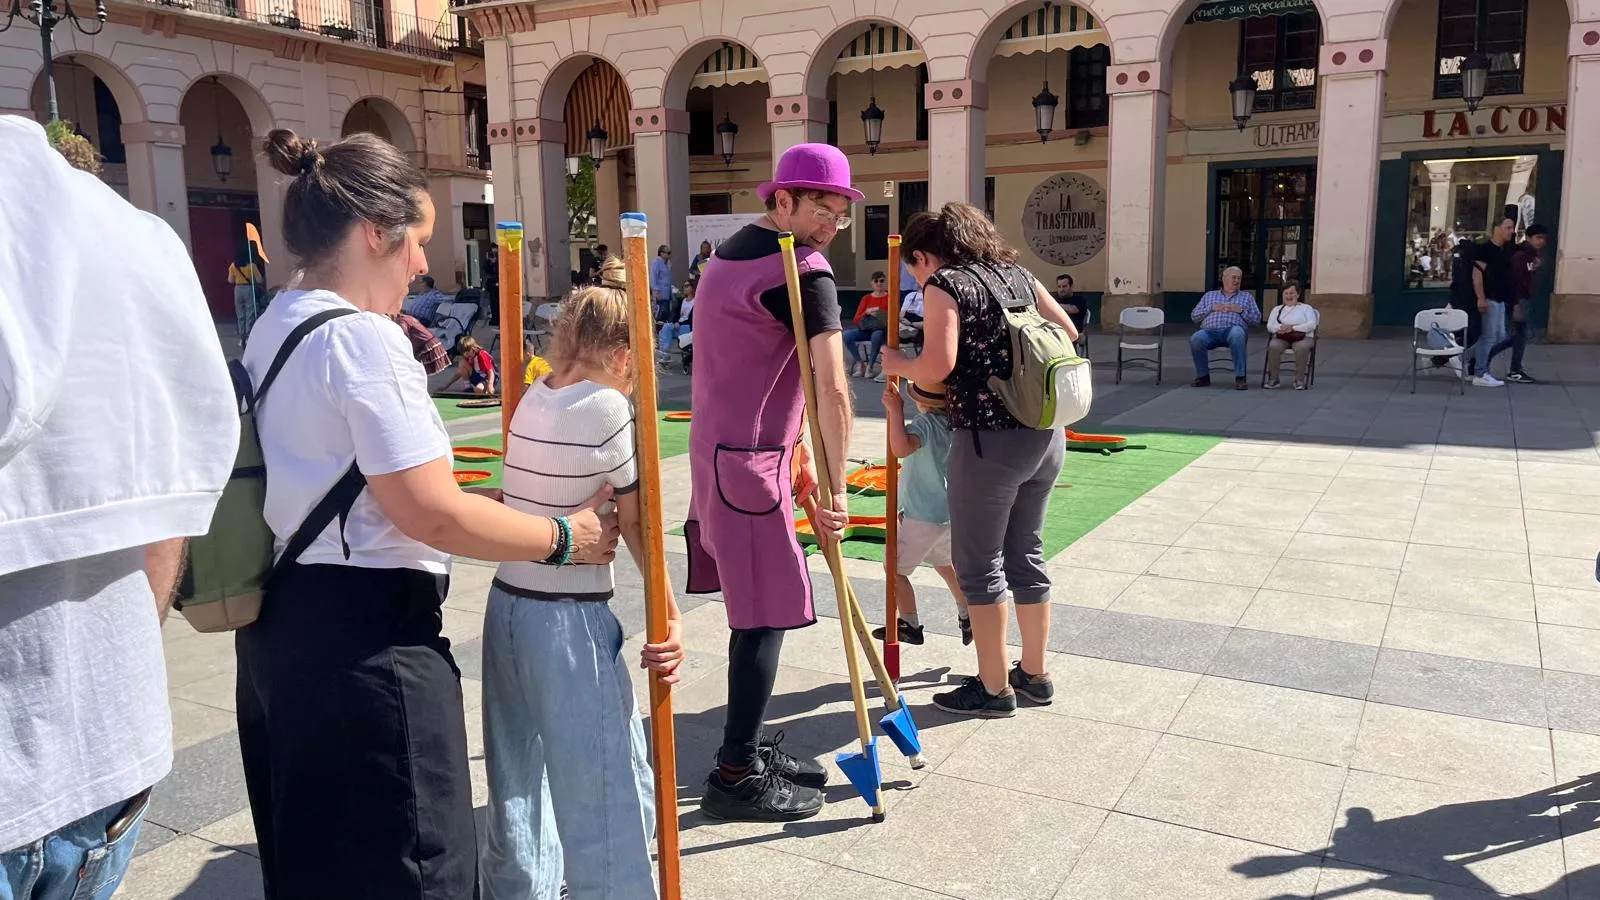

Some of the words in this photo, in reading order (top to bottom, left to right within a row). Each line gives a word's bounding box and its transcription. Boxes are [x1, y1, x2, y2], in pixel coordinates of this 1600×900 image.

[1229, 5, 1244, 14] sus
[1423, 109, 1471, 139] LA
[1060, 193, 1072, 212] LA
[1035, 211, 1096, 230] TRASTIENDA
